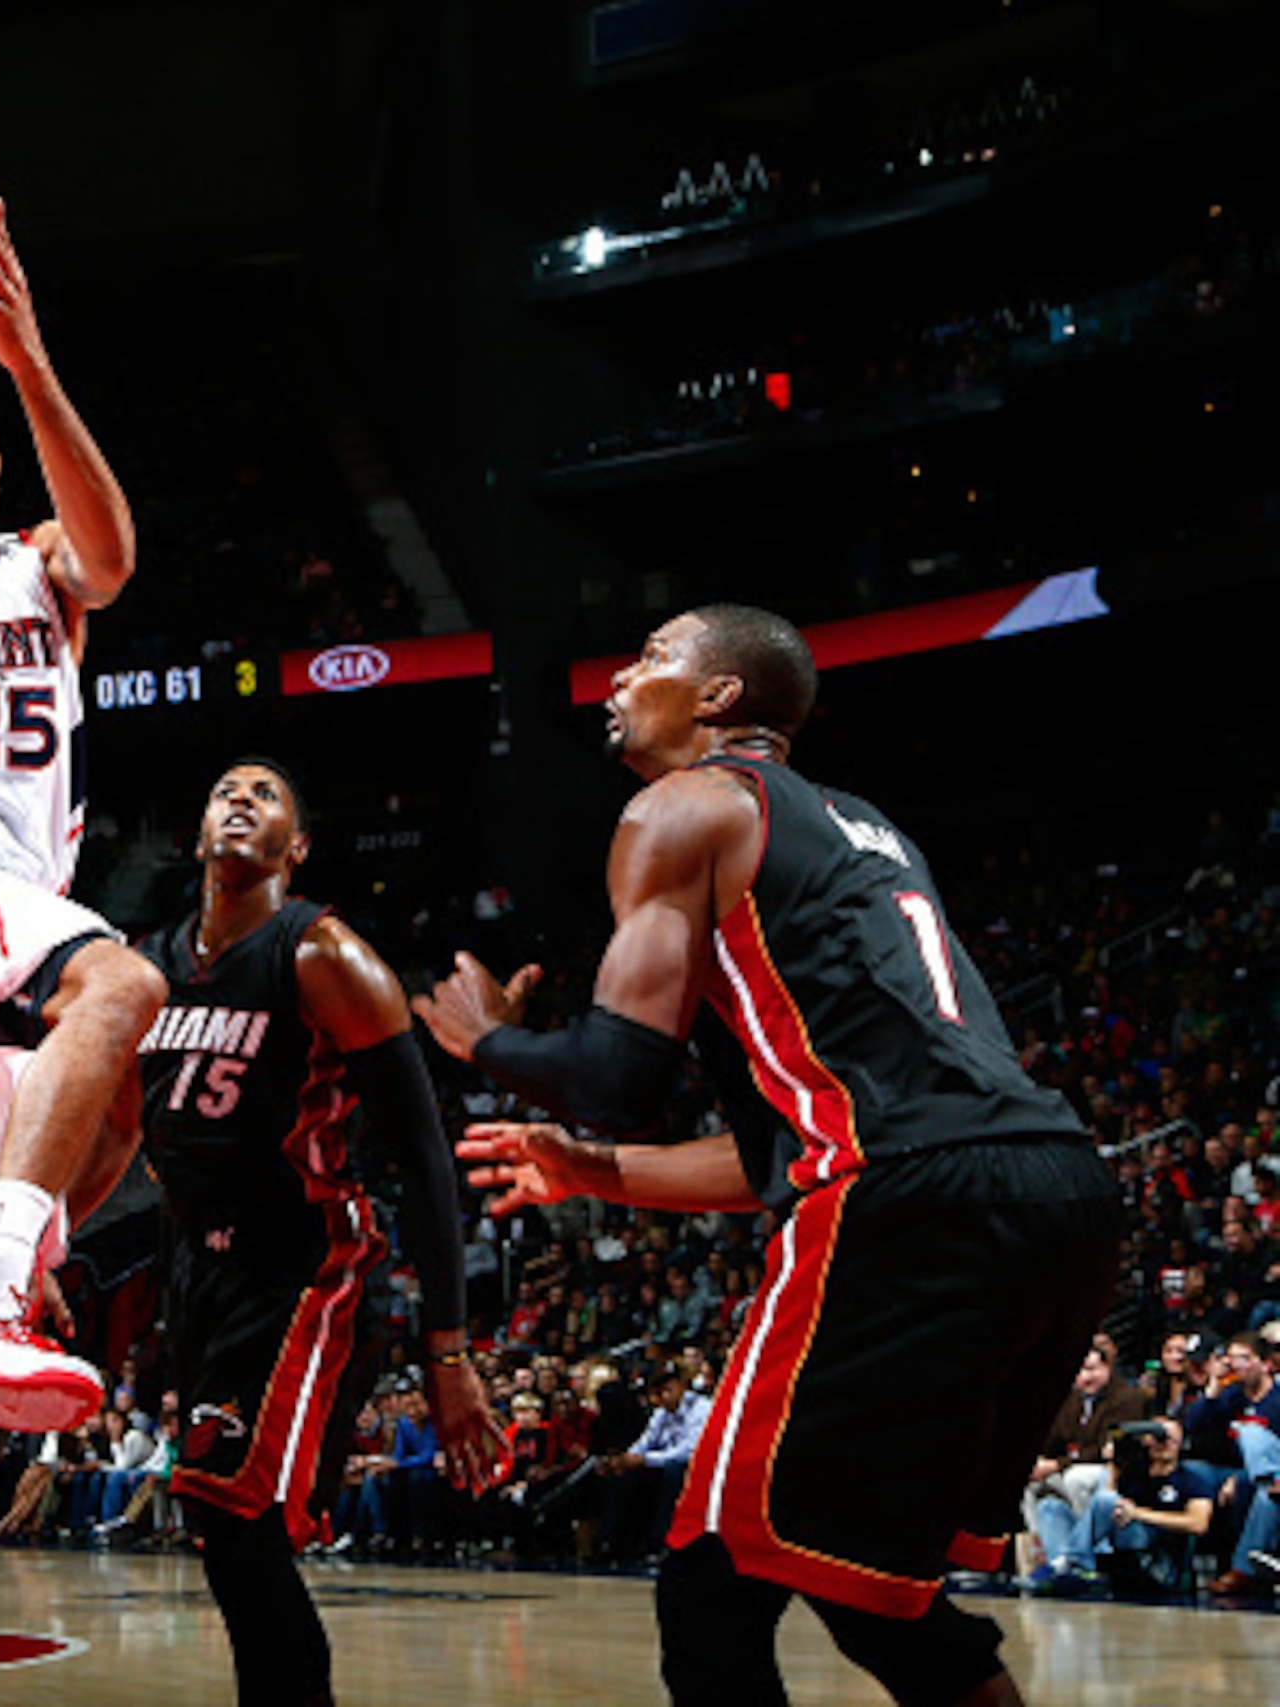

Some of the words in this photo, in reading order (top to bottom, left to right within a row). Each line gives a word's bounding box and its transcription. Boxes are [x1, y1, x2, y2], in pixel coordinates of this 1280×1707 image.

[166, 667, 202, 703] 61
[236, 662, 257, 695] 3
[892, 891, 966, 1025] 1
[166, 1052, 248, 1120] 15
